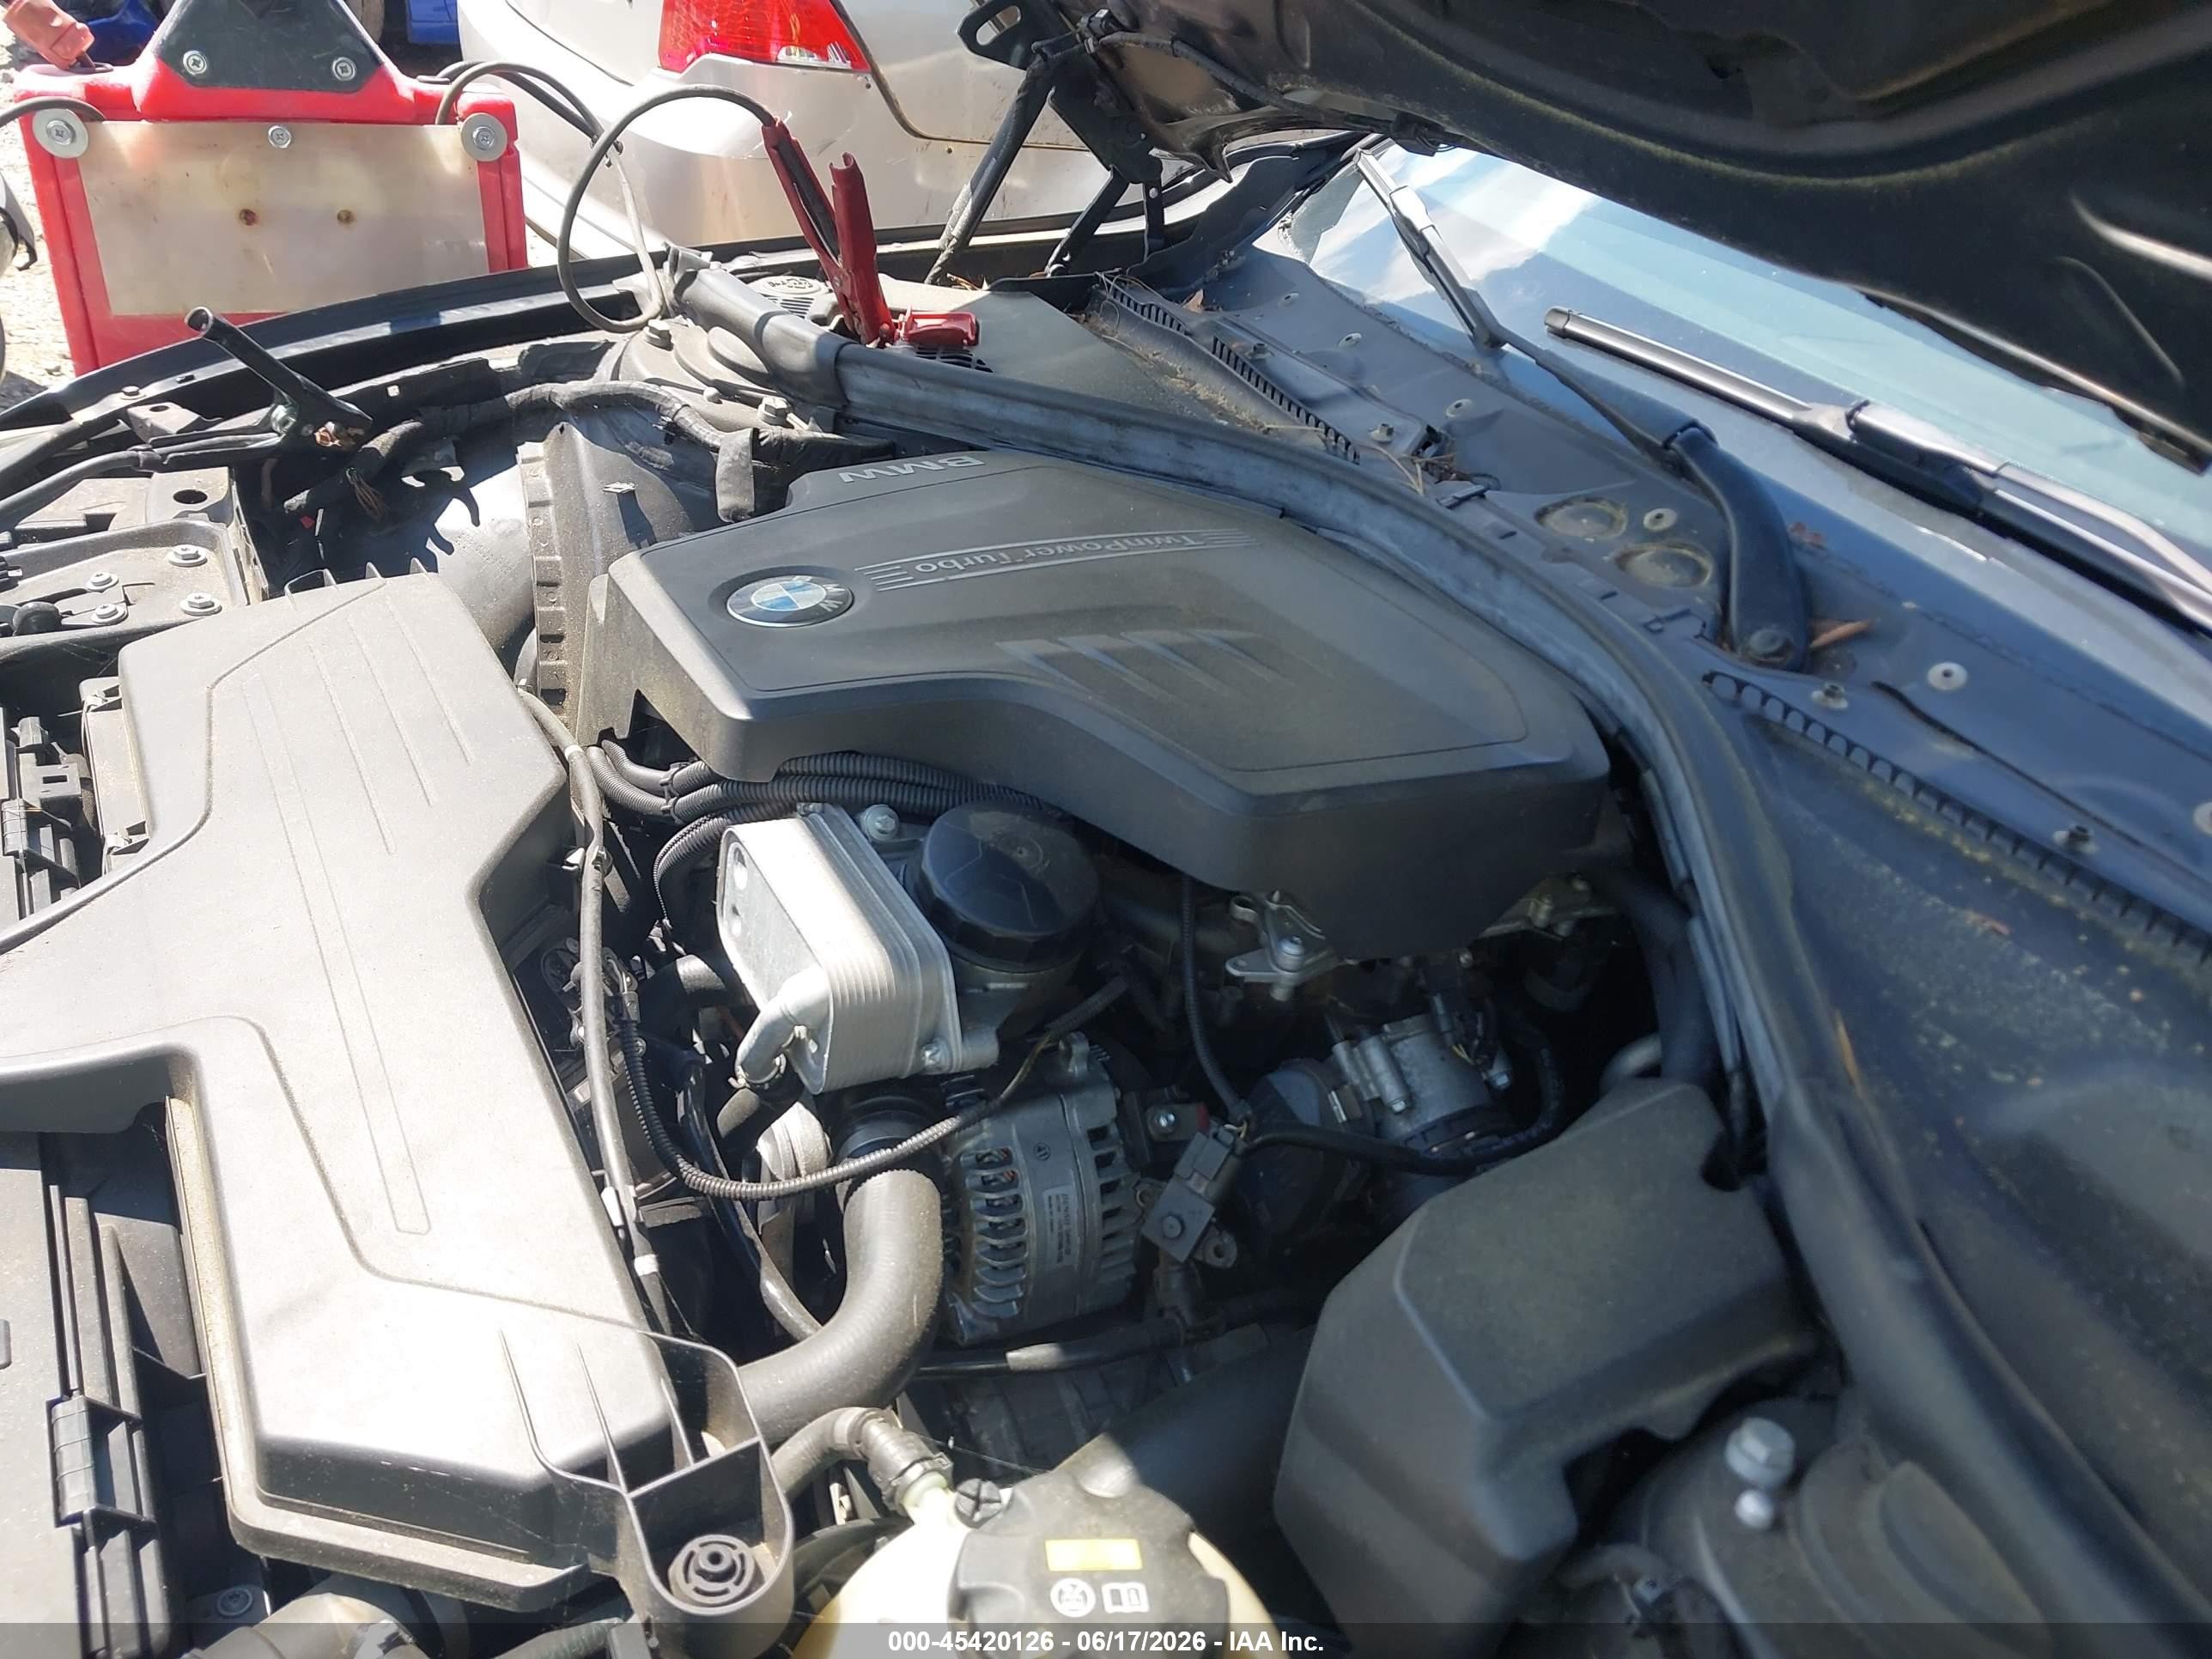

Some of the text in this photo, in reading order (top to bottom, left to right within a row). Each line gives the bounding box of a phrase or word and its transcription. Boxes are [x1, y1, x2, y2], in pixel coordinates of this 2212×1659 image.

[838, 456, 985, 483] BMW
[915, 534, 1205, 573] TwinPower Turbo
[793, 575, 846, 612] BMW
